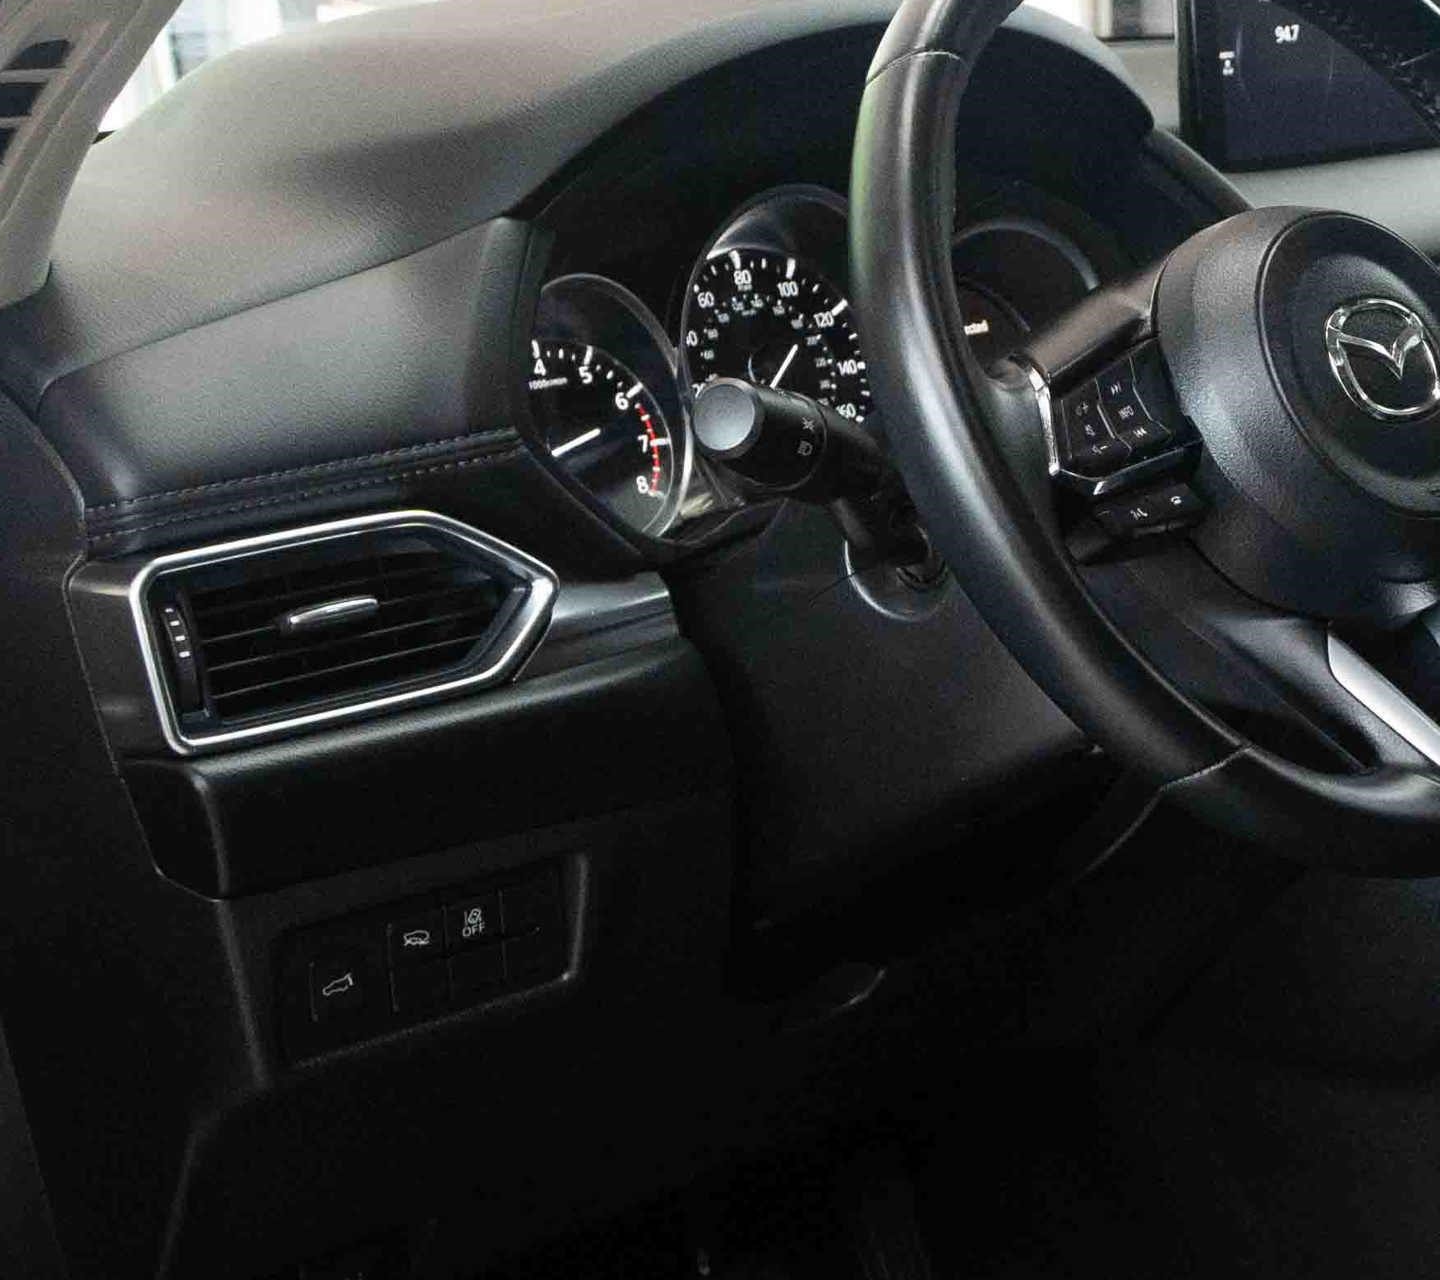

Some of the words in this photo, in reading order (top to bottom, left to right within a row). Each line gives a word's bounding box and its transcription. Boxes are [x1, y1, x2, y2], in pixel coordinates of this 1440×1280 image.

[733, 269, 752, 286] 80
[777, 281, 799, 297] 100
[697, 291, 715, 308] 60
[813, 312, 835, 328] 120
[533, 358, 547, 376] 4
[578, 365, 593, 384] 5
[837, 359, 858, 377] 140
[614, 391, 629, 410] 6
[637, 434, 649, 454] 7
[636, 475, 649, 495] 8
